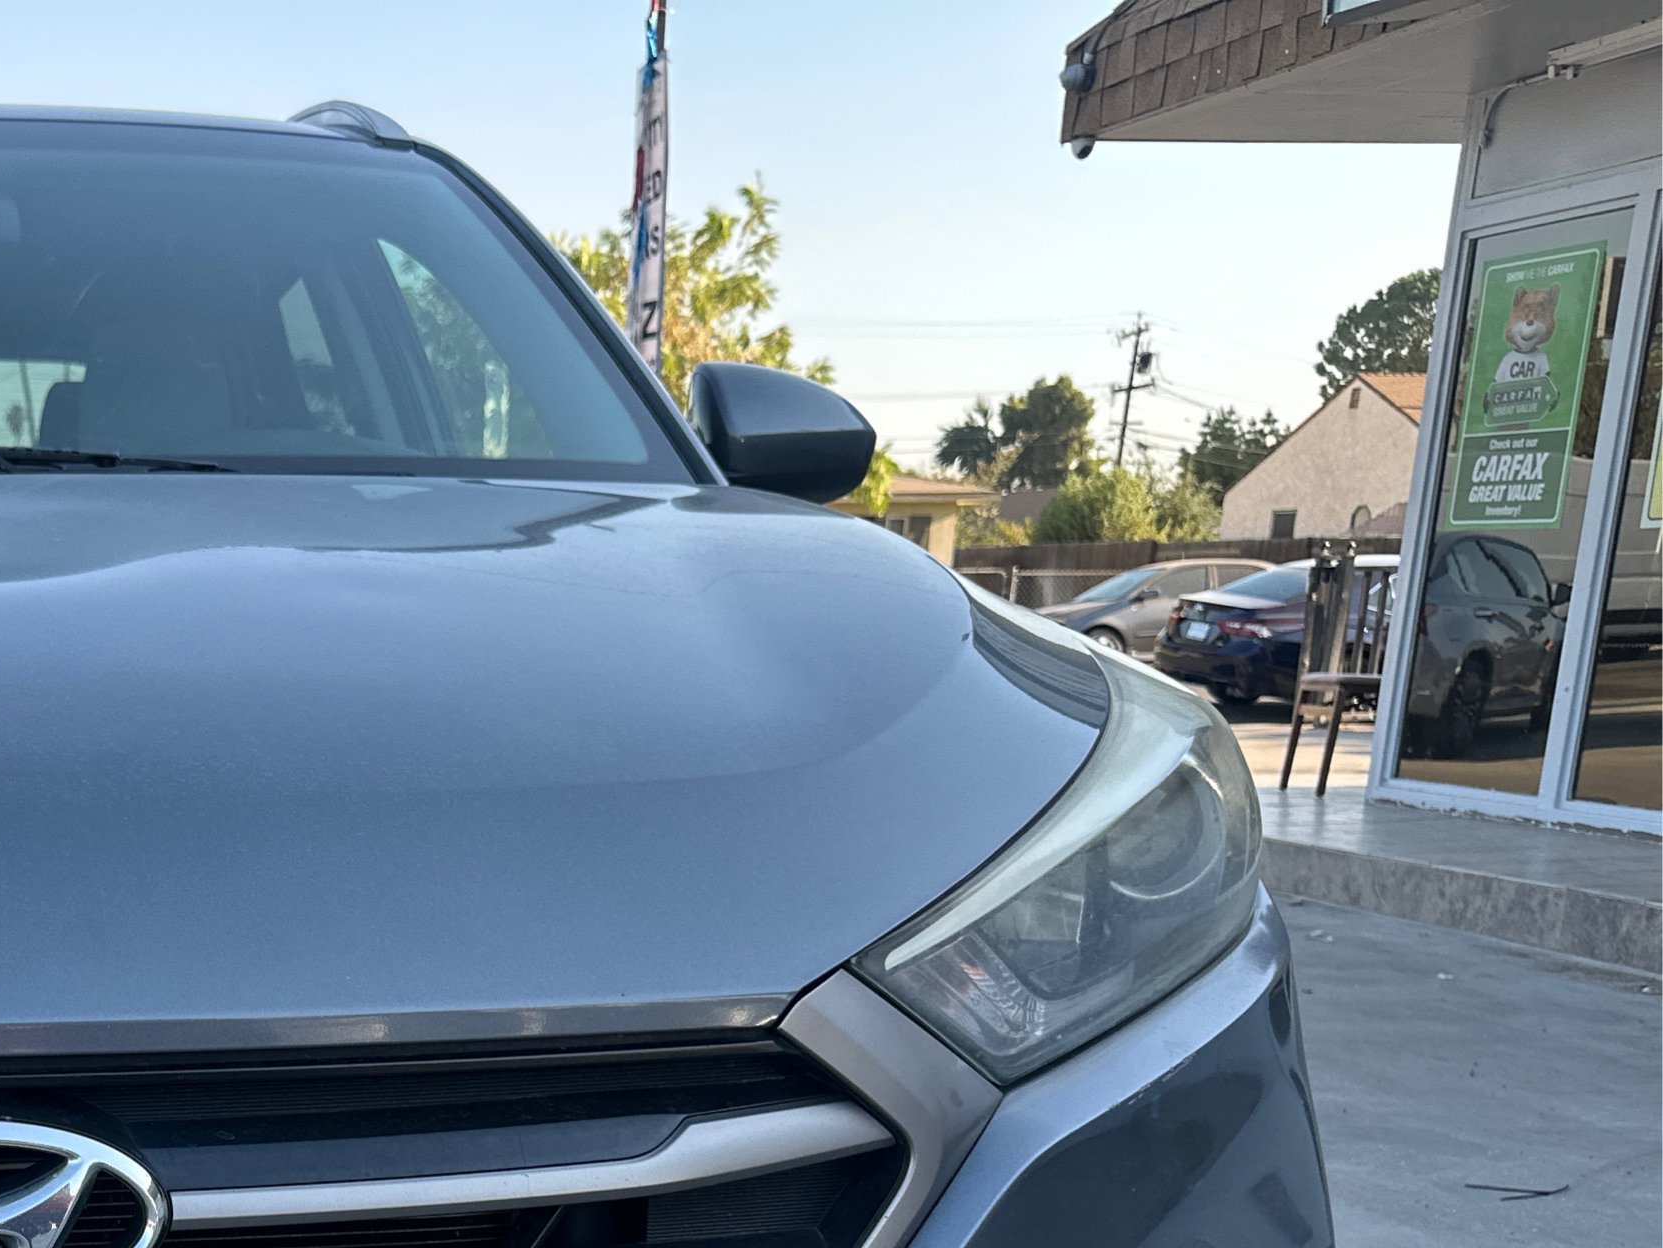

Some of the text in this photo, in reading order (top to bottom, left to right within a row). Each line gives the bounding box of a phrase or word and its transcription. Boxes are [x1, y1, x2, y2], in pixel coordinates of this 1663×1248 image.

[1509, 361, 1536, 379] CAR
[1489, 438, 1539, 450] Check out our
[1471, 452, 1550, 484] CARFAX
[1468, 483, 1545, 503] GREAT VALUE
